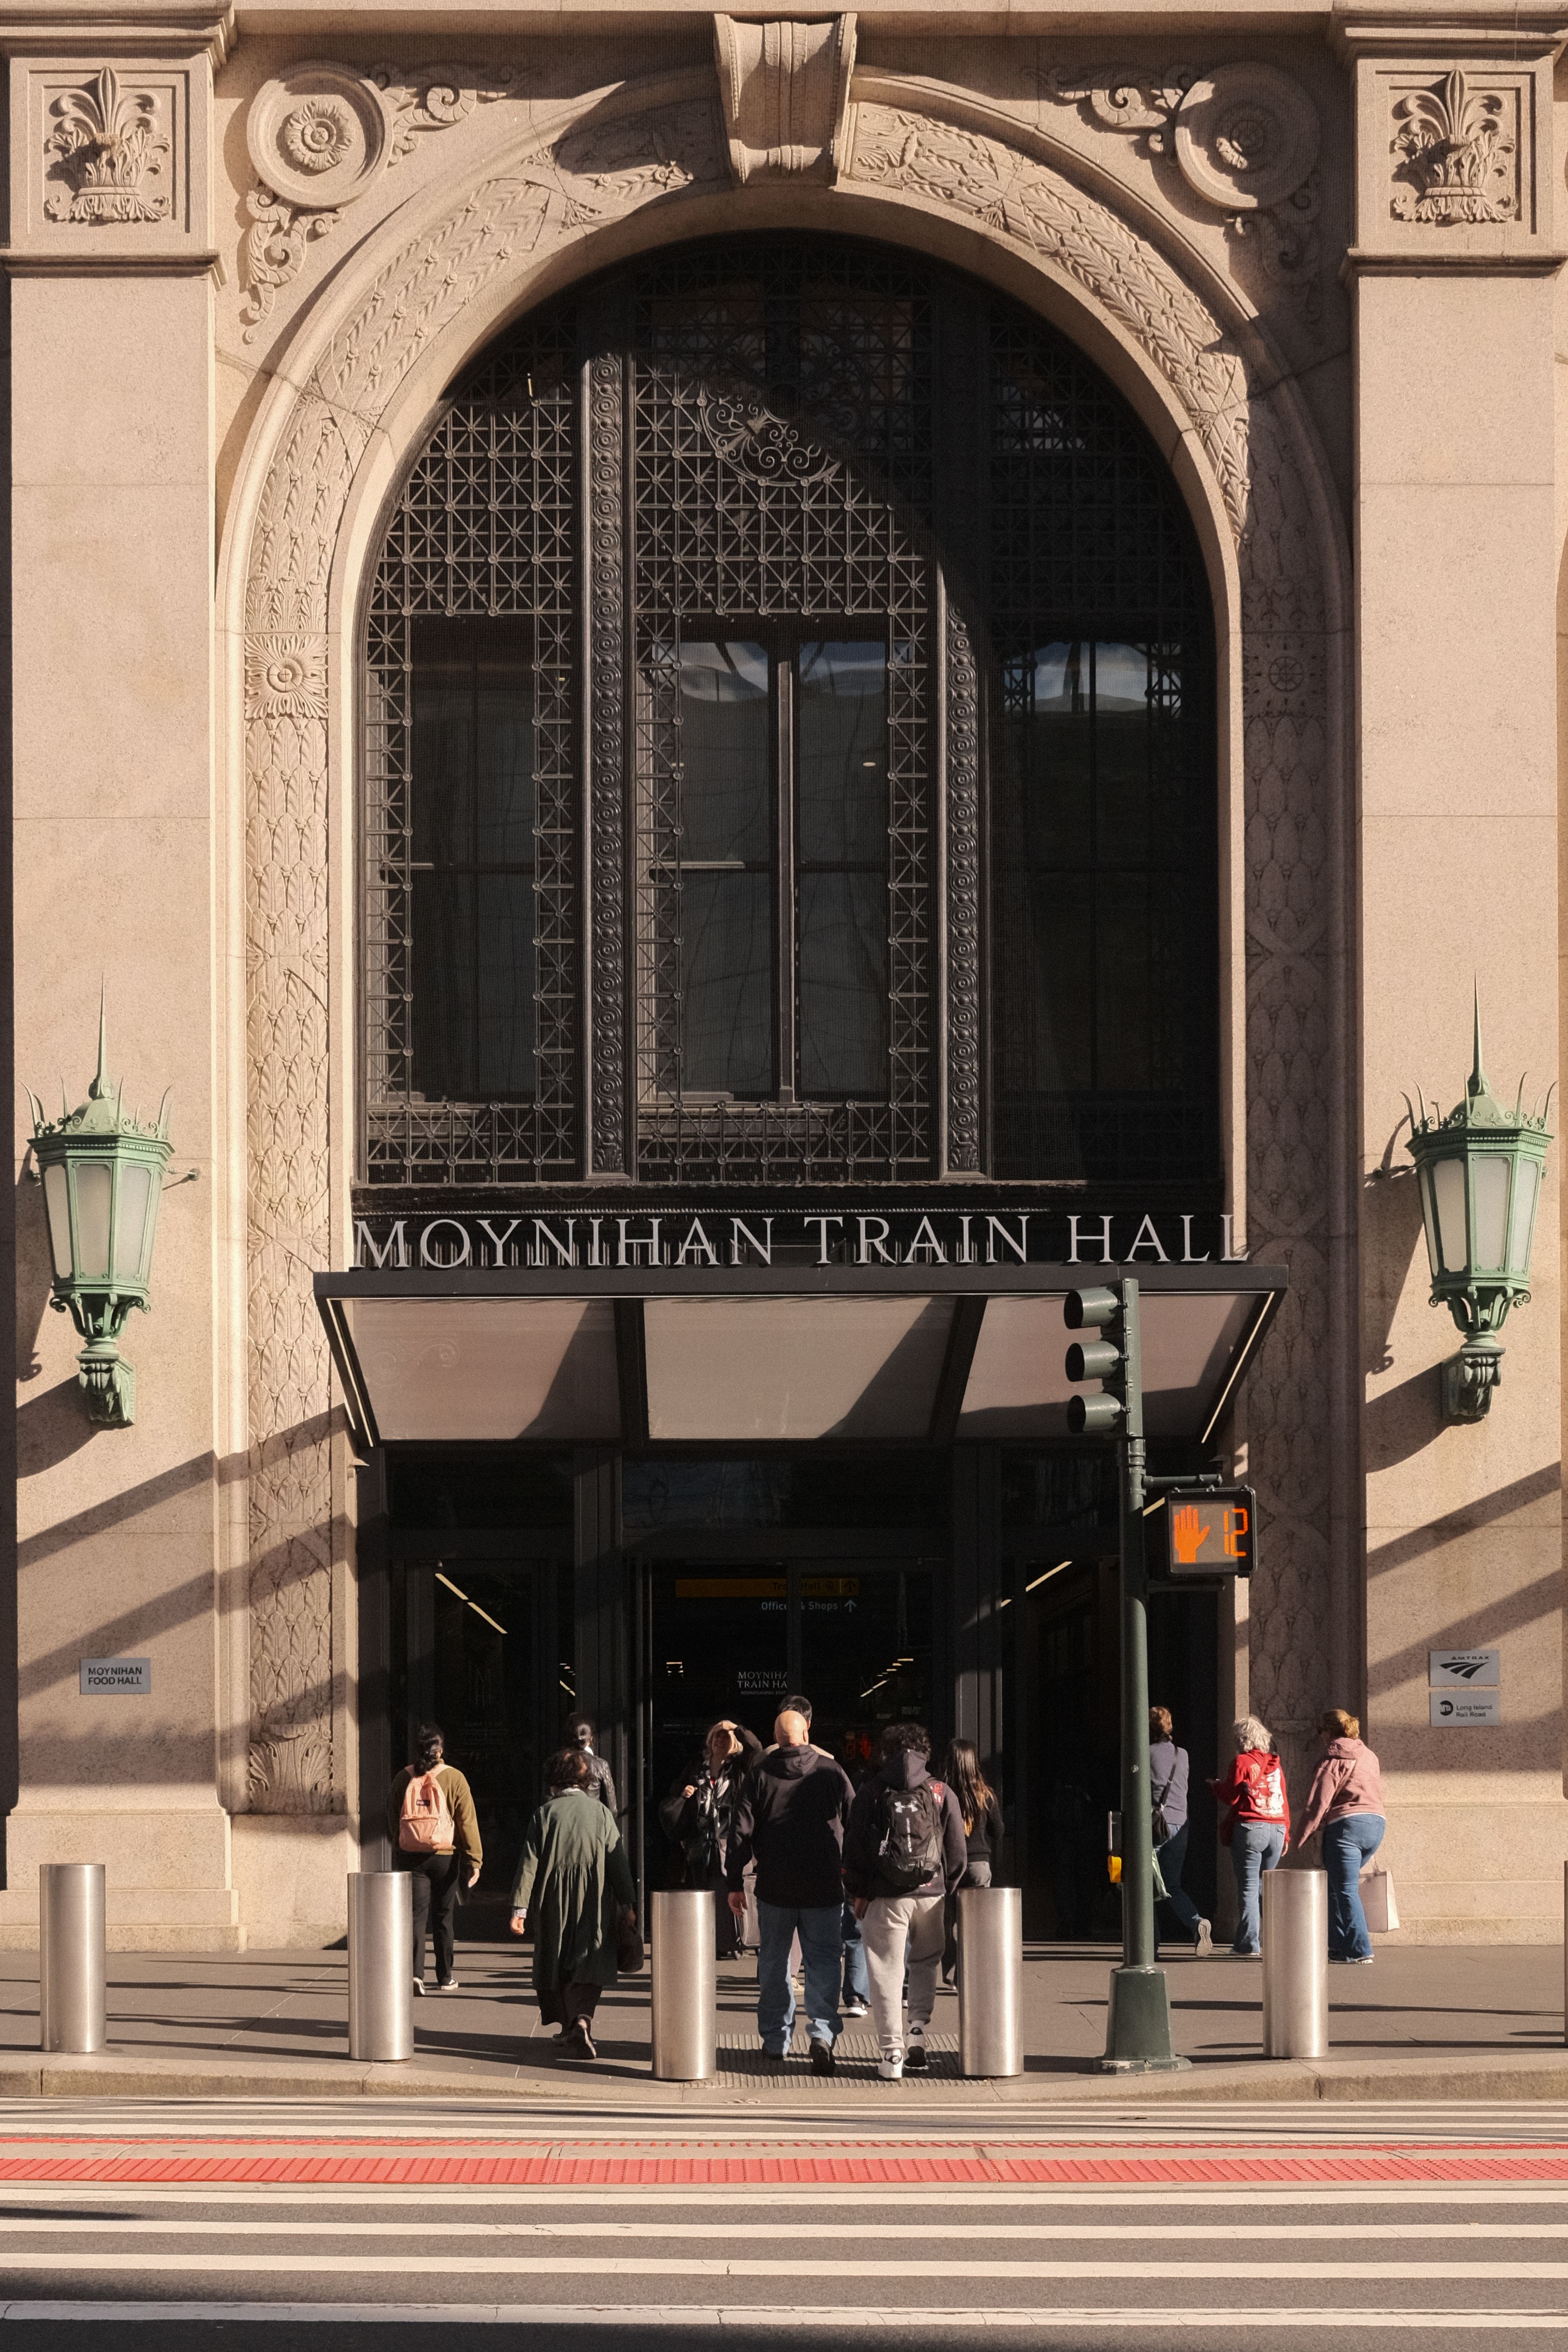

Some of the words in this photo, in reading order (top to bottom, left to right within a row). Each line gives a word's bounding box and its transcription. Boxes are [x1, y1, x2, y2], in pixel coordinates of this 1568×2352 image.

[353, 1217, 775, 1268] MOYNIHAN
[804, 1215, 1030, 1264] TRAIN
[1066, 1213, 1250, 1263] HALL
[1223, 1508, 1248, 1557] 12
[761, 1601, 787, 1610] Offic
[808, 1601, 838, 1612] Shops
[88, 1667, 142, 1676] MOYNIHAN
[738, 1671, 787, 1679] MOYNIHA
[88, 1677, 116, 1685] FOOD
[118, 1676, 142, 1685] HALL
[737, 1680, 769, 1688] TRAIN
[773, 1680, 788, 1688] HA
